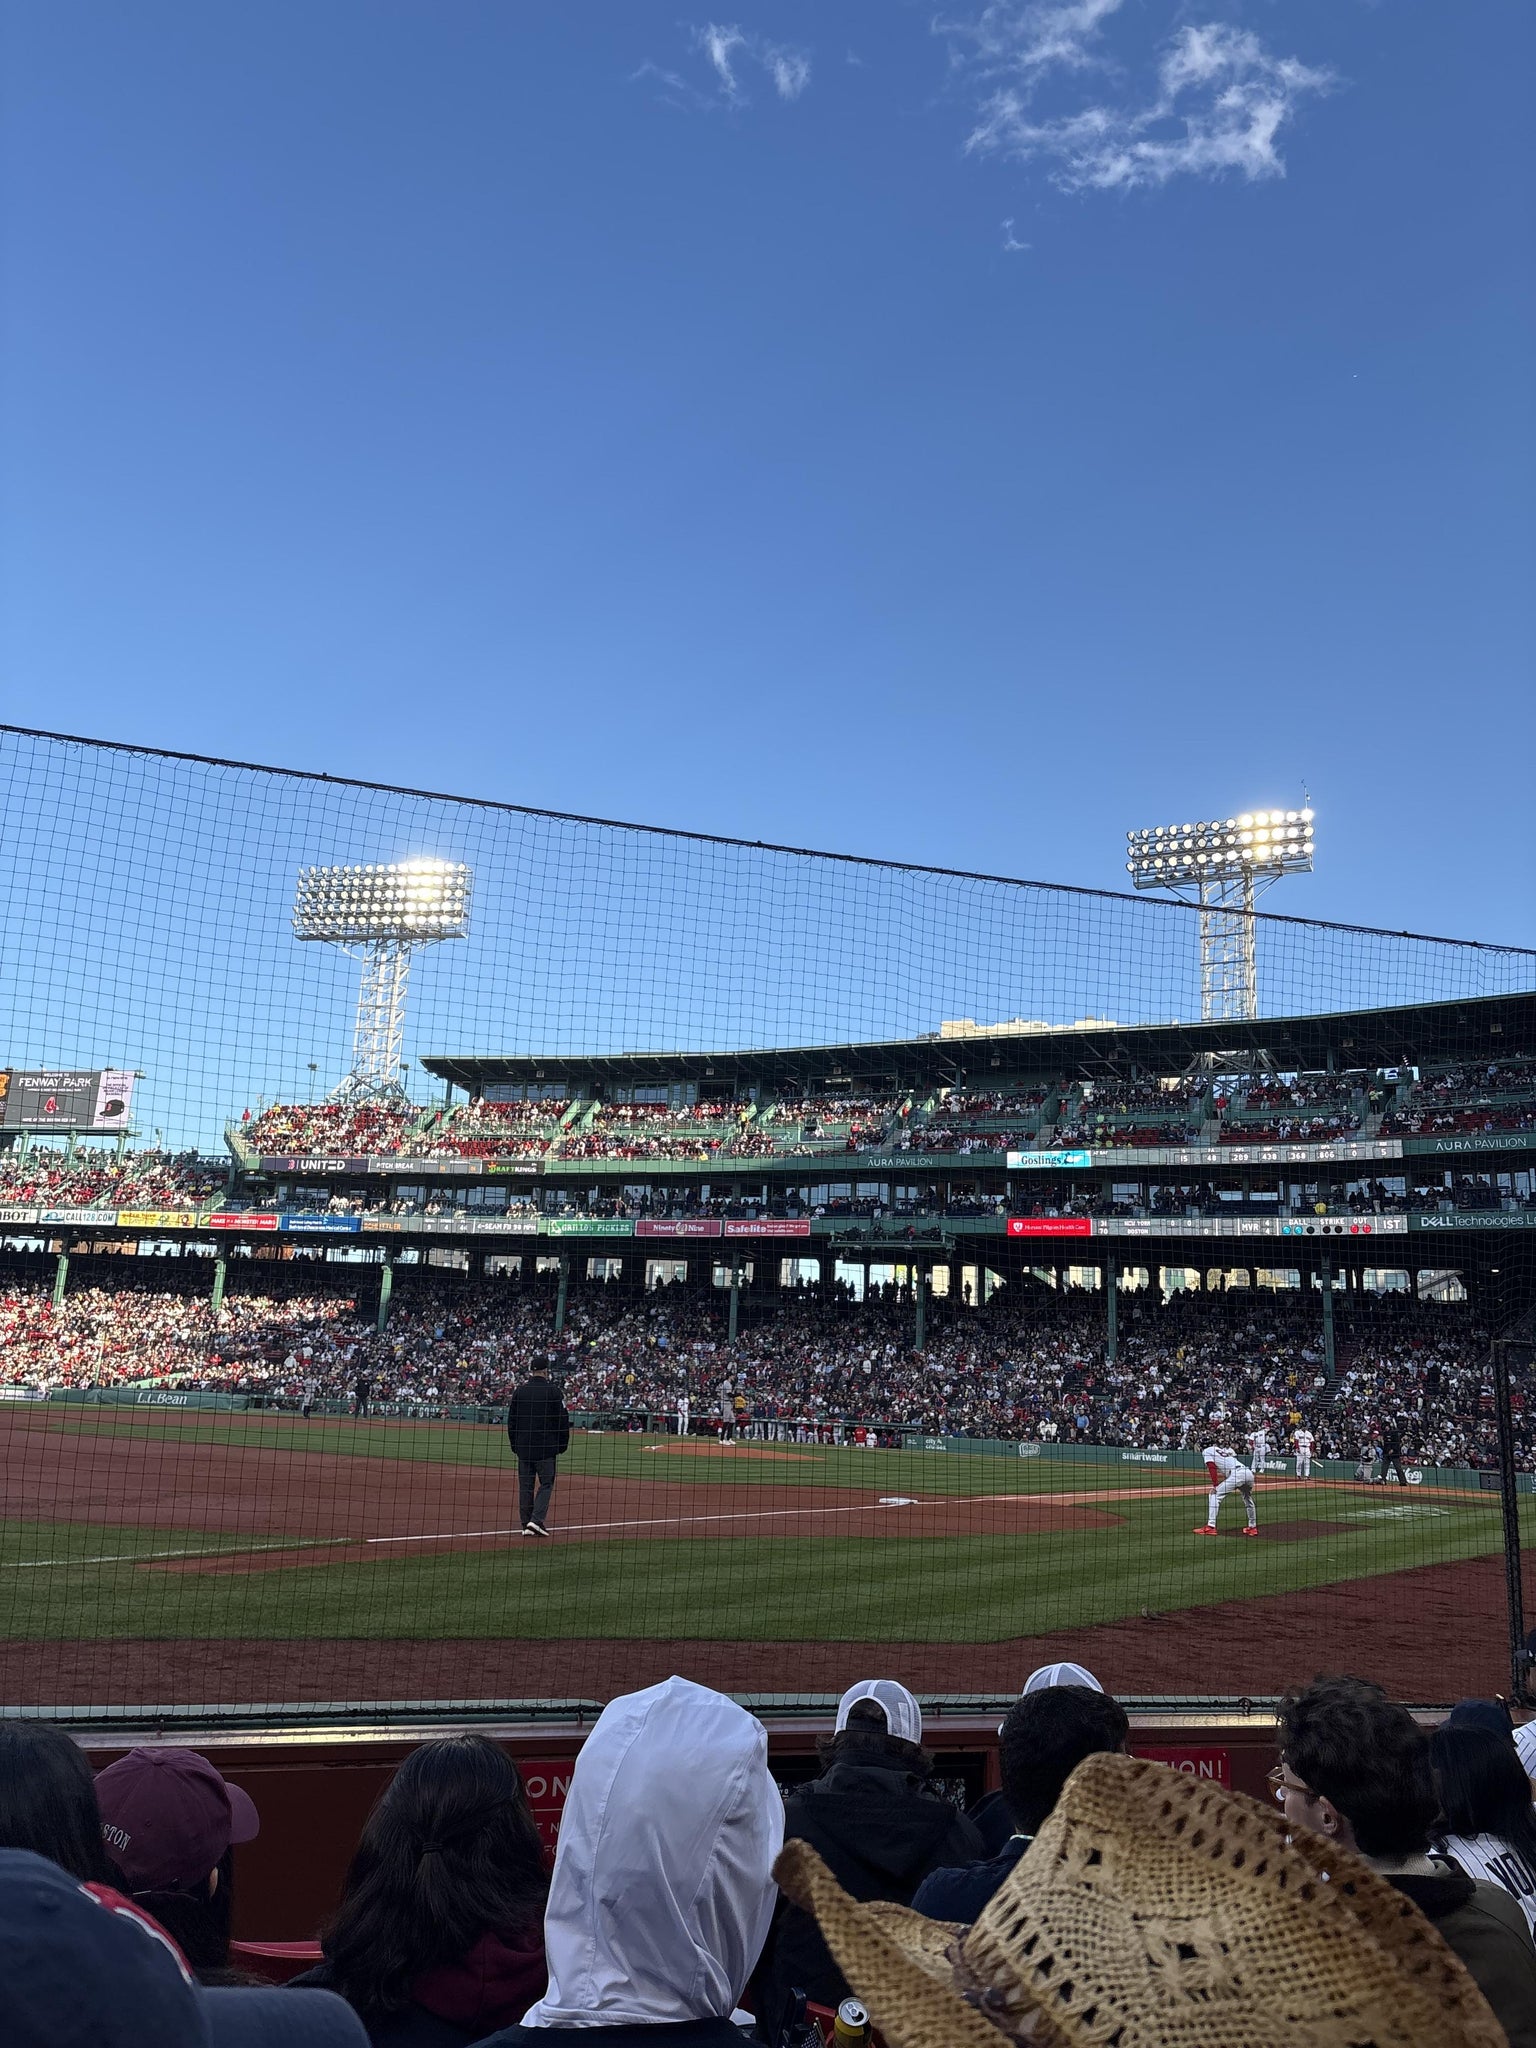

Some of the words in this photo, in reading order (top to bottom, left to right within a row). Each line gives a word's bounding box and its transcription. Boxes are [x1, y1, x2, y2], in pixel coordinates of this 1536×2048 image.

[19, 1077, 60, 1087] FENWAY
[63, 1078, 93, 1088] PARK
[1474, 1138, 1527, 1149] PAVILION
[896, 1158, 933, 1166] PAVILION
[1021, 1155, 1062, 1165] Goslings
[1288, 1218, 1307, 1226] BALL
[1421, 1216, 1453, 1227] DELL
[1453, 1215, 1523, 1227] Technologies
[597, 1223, 630, 1232] PICKLES
[653, 1224, 675, 1232] Ninety
[688, 1224, 705, 1232] Nine
[727, 1224, 767, 1233] Safelite
[1241, 1223, 1259, 1231] MVR
[1122, 1452, 1168, 1463] smartwater
[101, 1823, 132, 1852] STON
